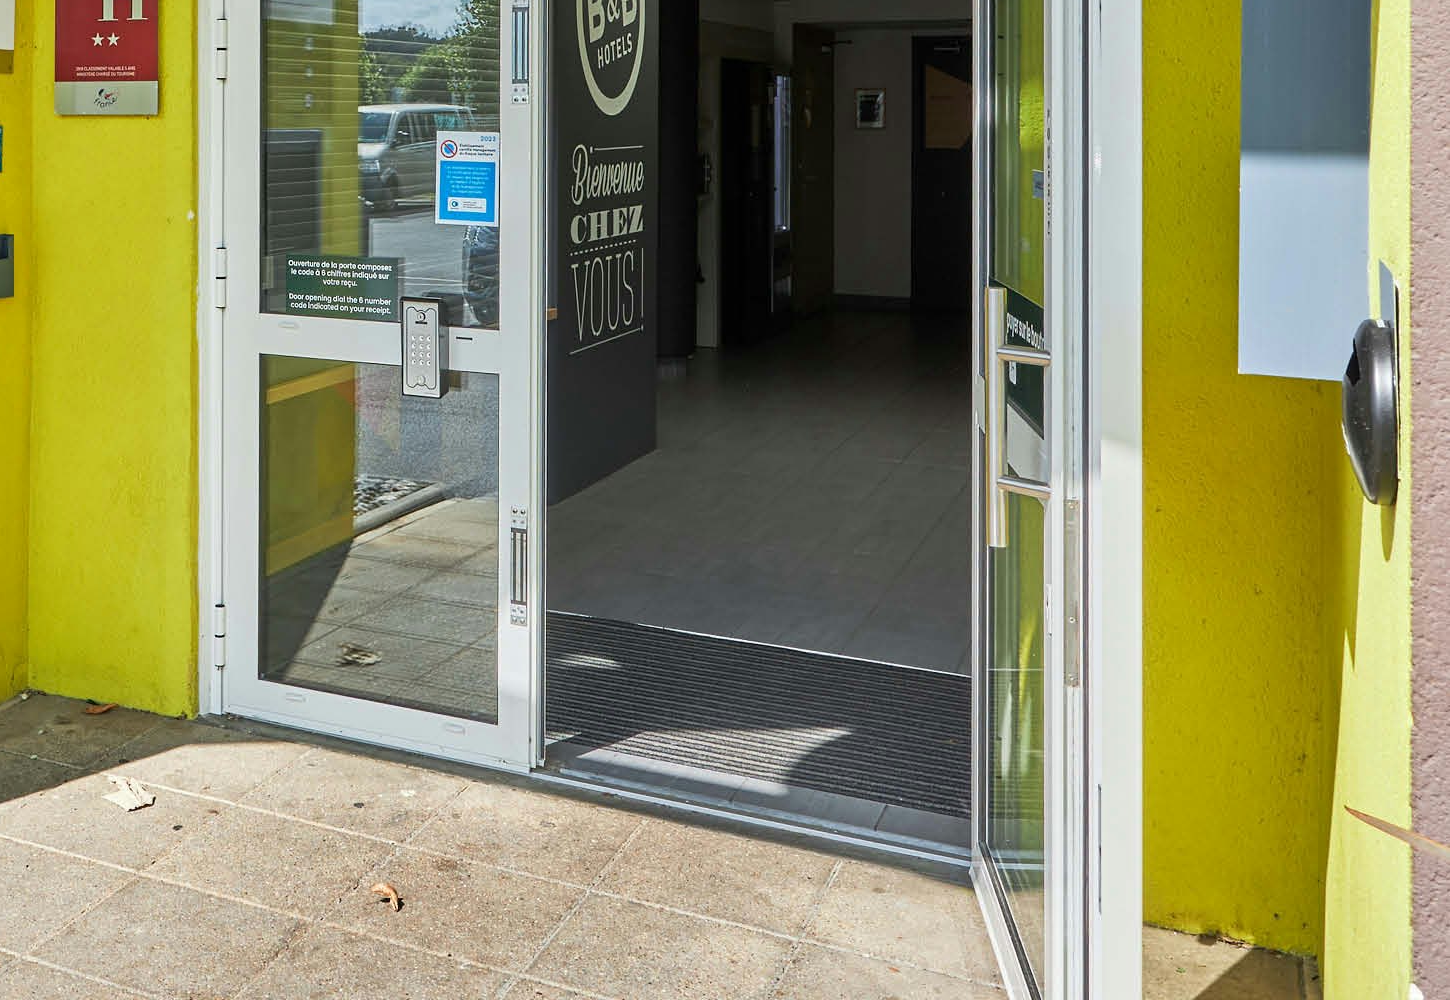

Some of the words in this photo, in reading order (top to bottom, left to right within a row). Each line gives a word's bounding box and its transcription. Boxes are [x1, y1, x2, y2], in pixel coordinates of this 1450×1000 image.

[597, 33, 632, 69] HOTELS
[571, 144, 645, 205] Bienvenue
[570, 205, 644, 244] CHEZ
[288, 260, 320, 268] Ouverture
[338, 262, 357, 270] porte
[357, 263, 392, 272] composez
[298, 268, 314, 276] code
[327, 269, 351, 278] chiffres
[352, 271, 377, 280] indiqué
[341, 280, 358, 288] reçu.
[306, 294, 332, 303] opening
[364, 297, 392, 305] number
[308, 302, 339, 311] indicated
[366, 307, 391, 315] receipt.
